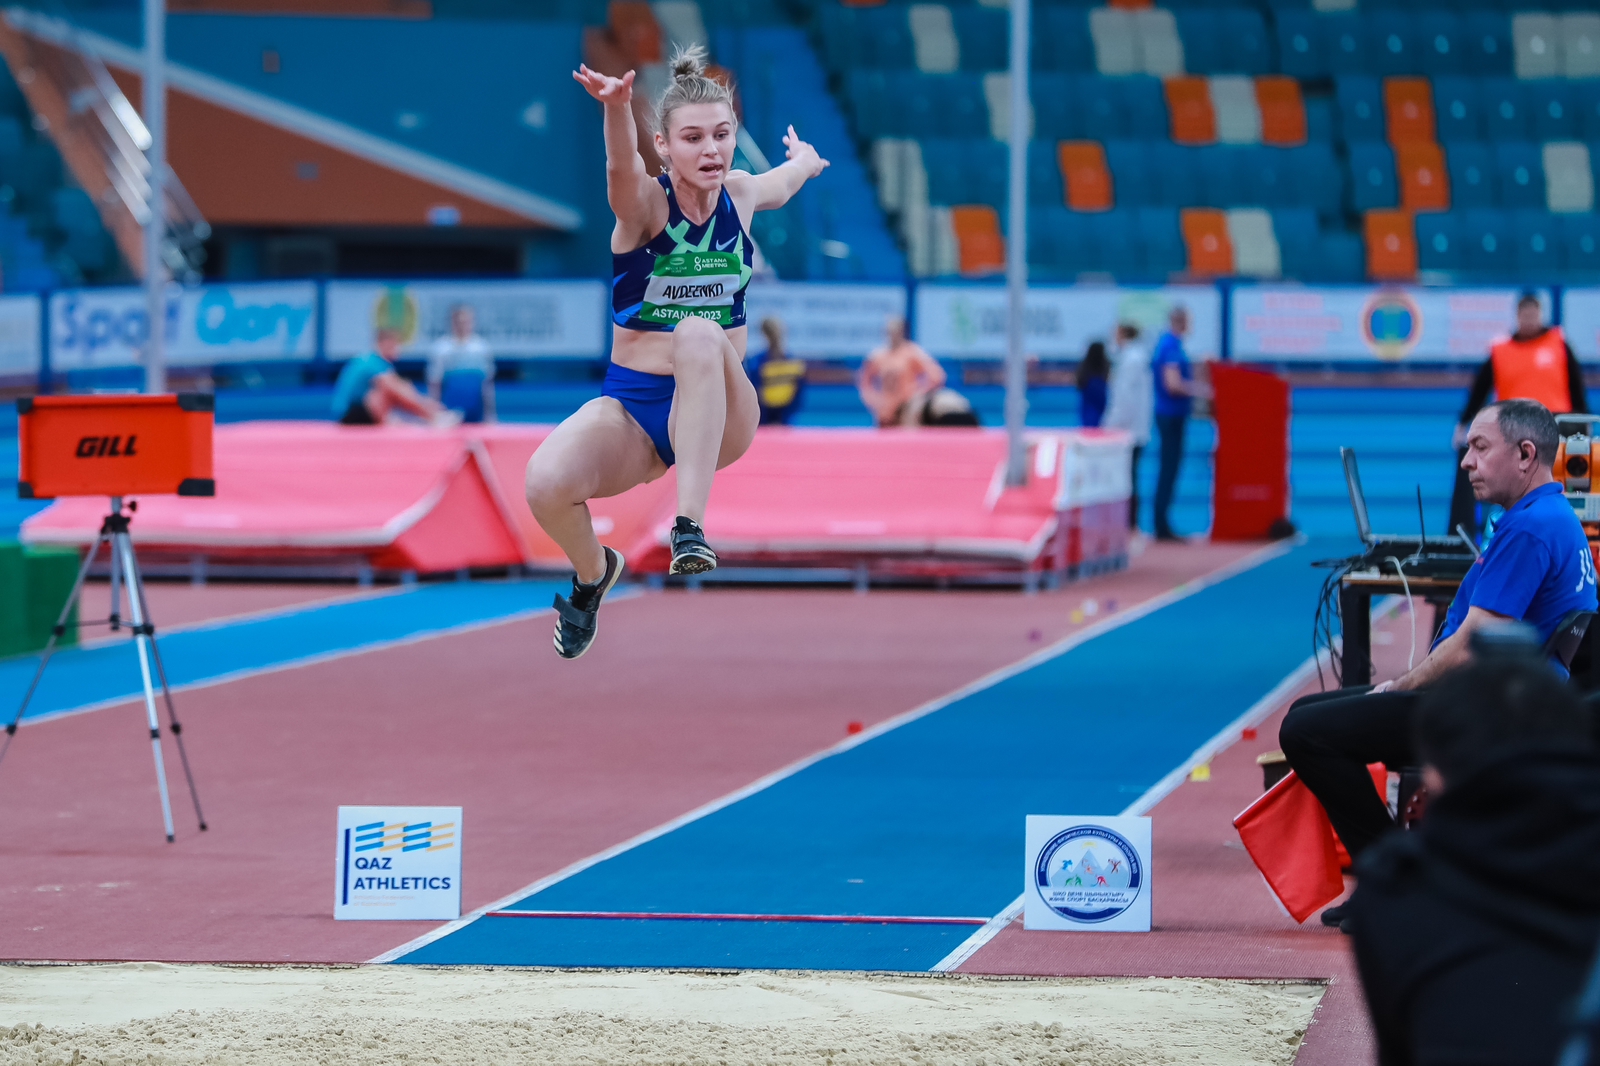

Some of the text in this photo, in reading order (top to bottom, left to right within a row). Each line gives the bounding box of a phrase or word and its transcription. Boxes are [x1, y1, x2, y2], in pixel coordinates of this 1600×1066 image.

[663, 283, 724, 299] AVDEENKO
[698, 310, 722, 320] 2023
[76, 435, 137, 458] GILL
[355, 857, 392, 870] QAZ
[353, 877, 451, 890] ATHLETICS
